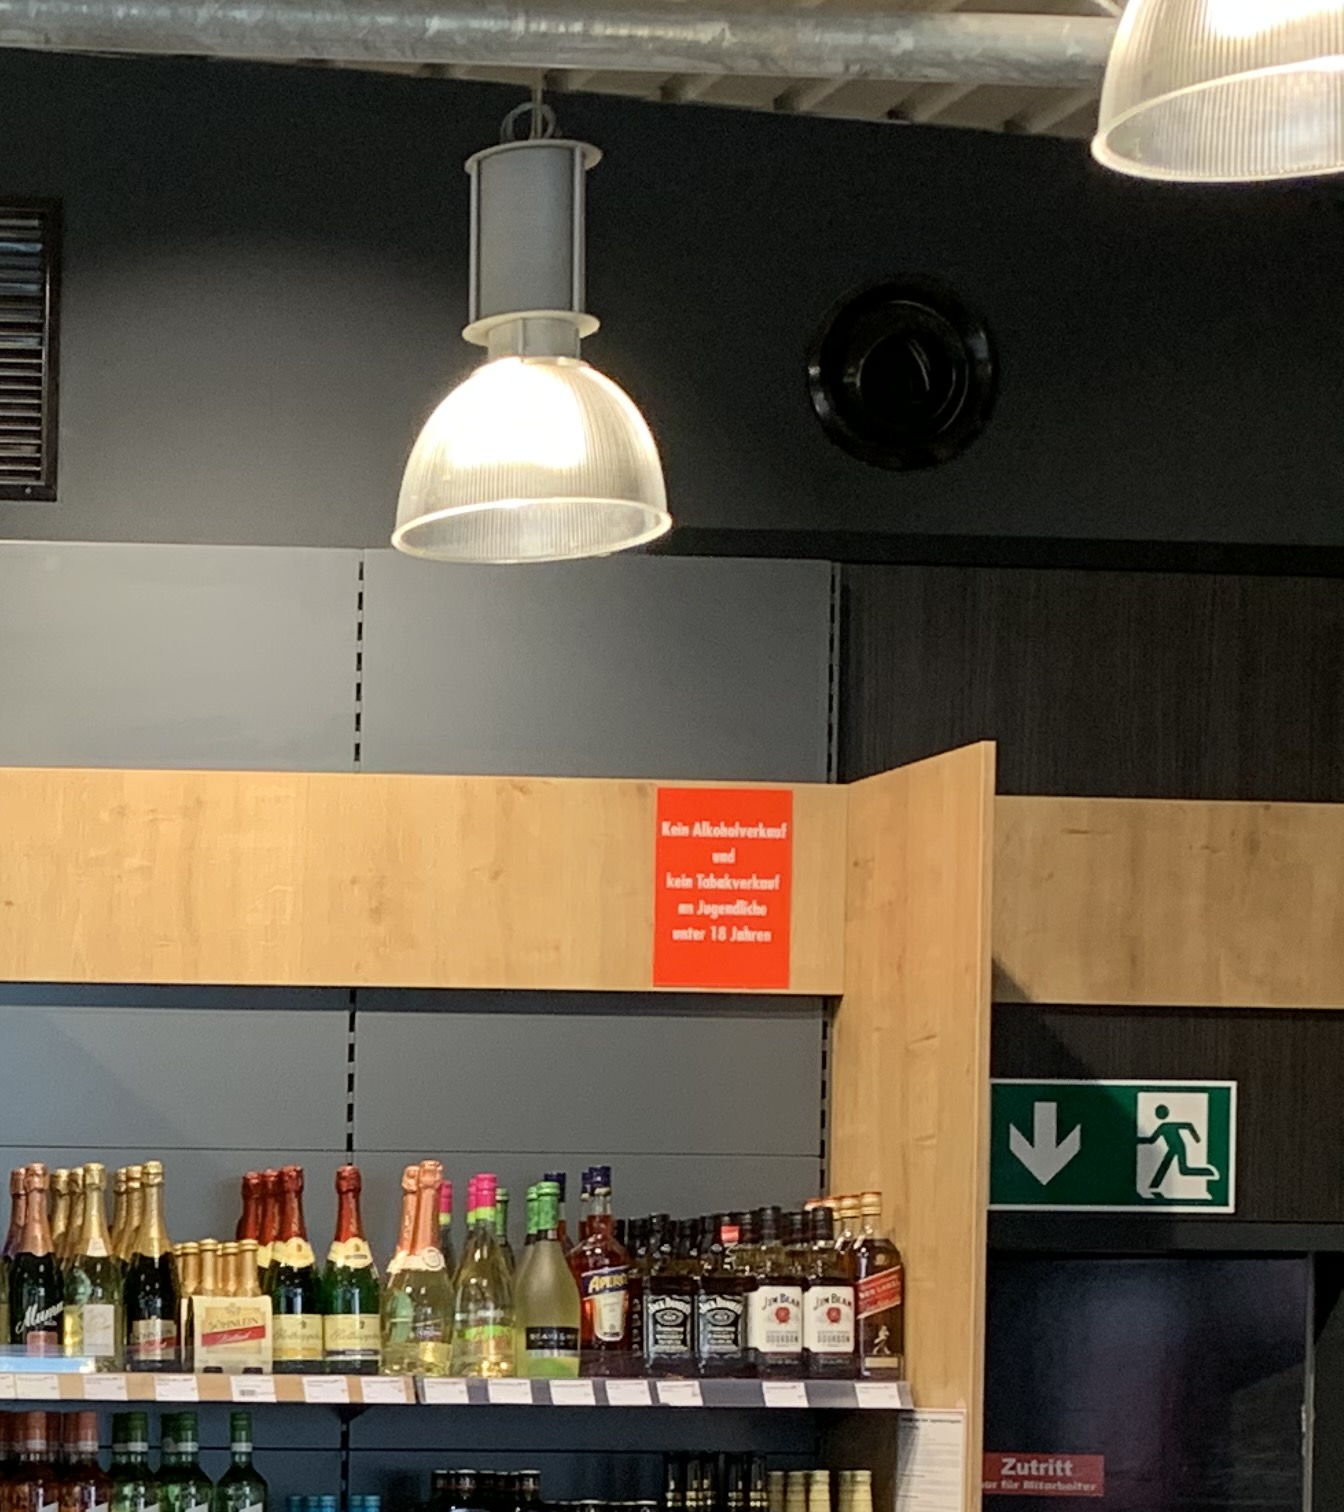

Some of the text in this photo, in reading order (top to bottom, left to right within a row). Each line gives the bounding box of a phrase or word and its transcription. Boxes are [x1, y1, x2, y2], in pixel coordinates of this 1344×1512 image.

[662, 821, 787, 839] Kein Alkoholverkauf
[712, 848, 736, 864] und
[666, 872, 780, 890] kein Tabakverkauf
[678, 900, 768, 919] an Jugendliche
[672, 926, 772, 942] unter 18 Jahren
[762, 1295, 779, 1309] JIM
[814, 1295, 830, 1309] JIM
[1001, 1457, 1073, 1477] Zutritt
[1001, 1479, 1097, 1493] für Mitarbeiter
